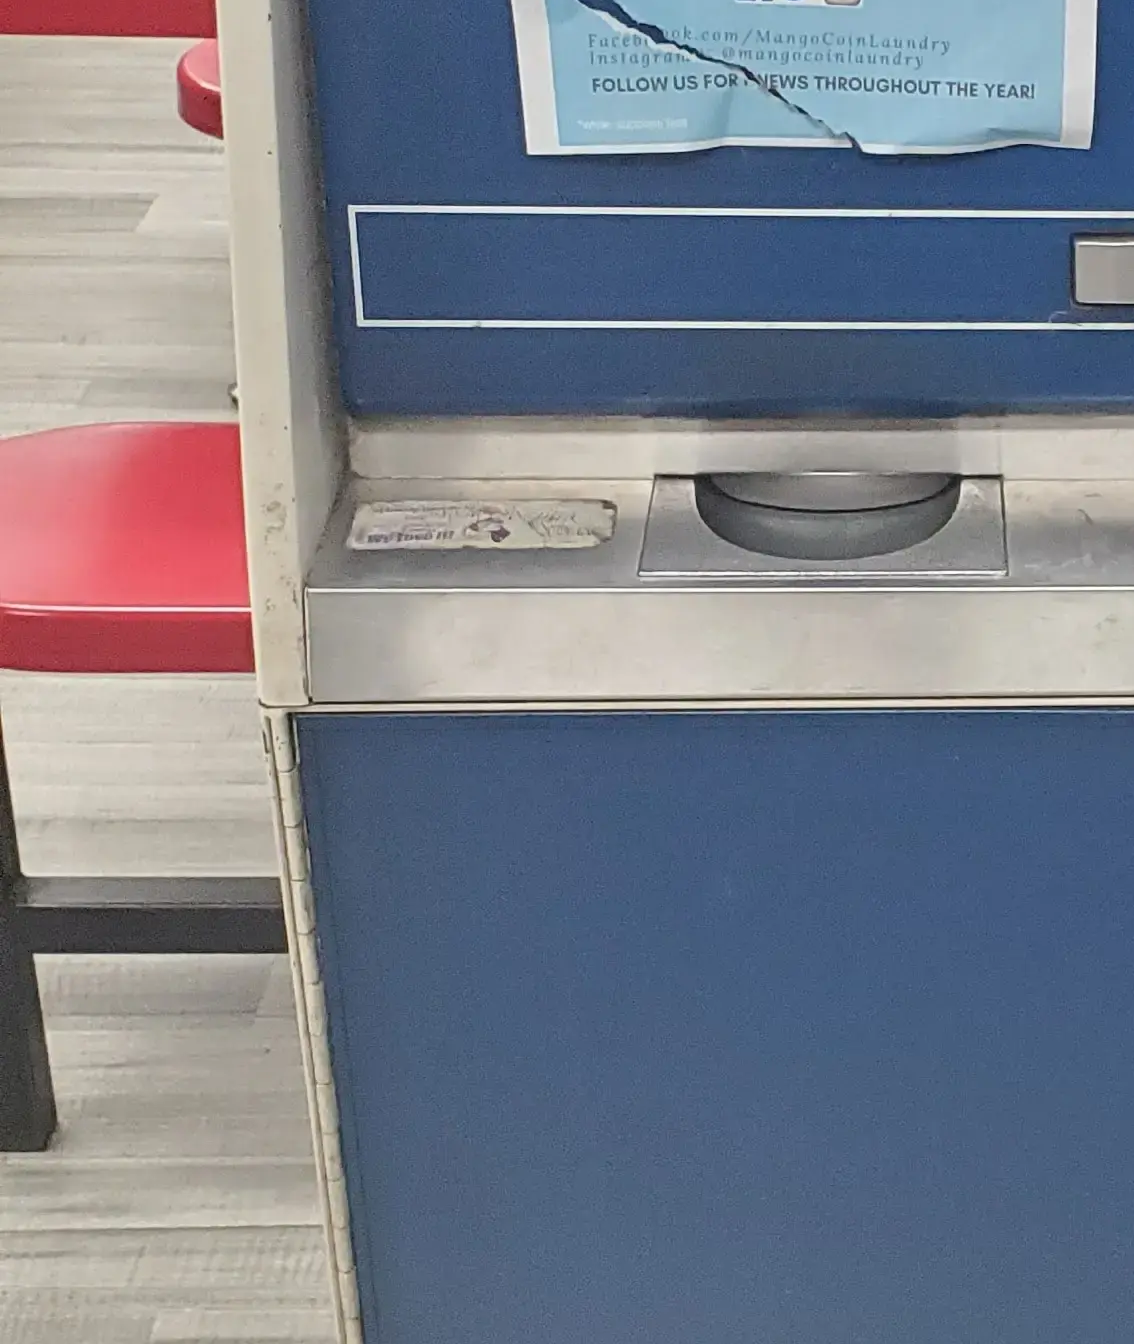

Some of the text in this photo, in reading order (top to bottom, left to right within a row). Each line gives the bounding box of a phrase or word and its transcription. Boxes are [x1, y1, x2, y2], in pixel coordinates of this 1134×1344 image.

[592, 75, 667, 93] FOLLOW
[673, 75, 698, 91] US
[704, 72, 738, 89] FOR
[814, 76, 941, 96] THROUGHOUT
[946, 81, 978, 98] THE
[984, 83, 1035, 100] YEAR!
